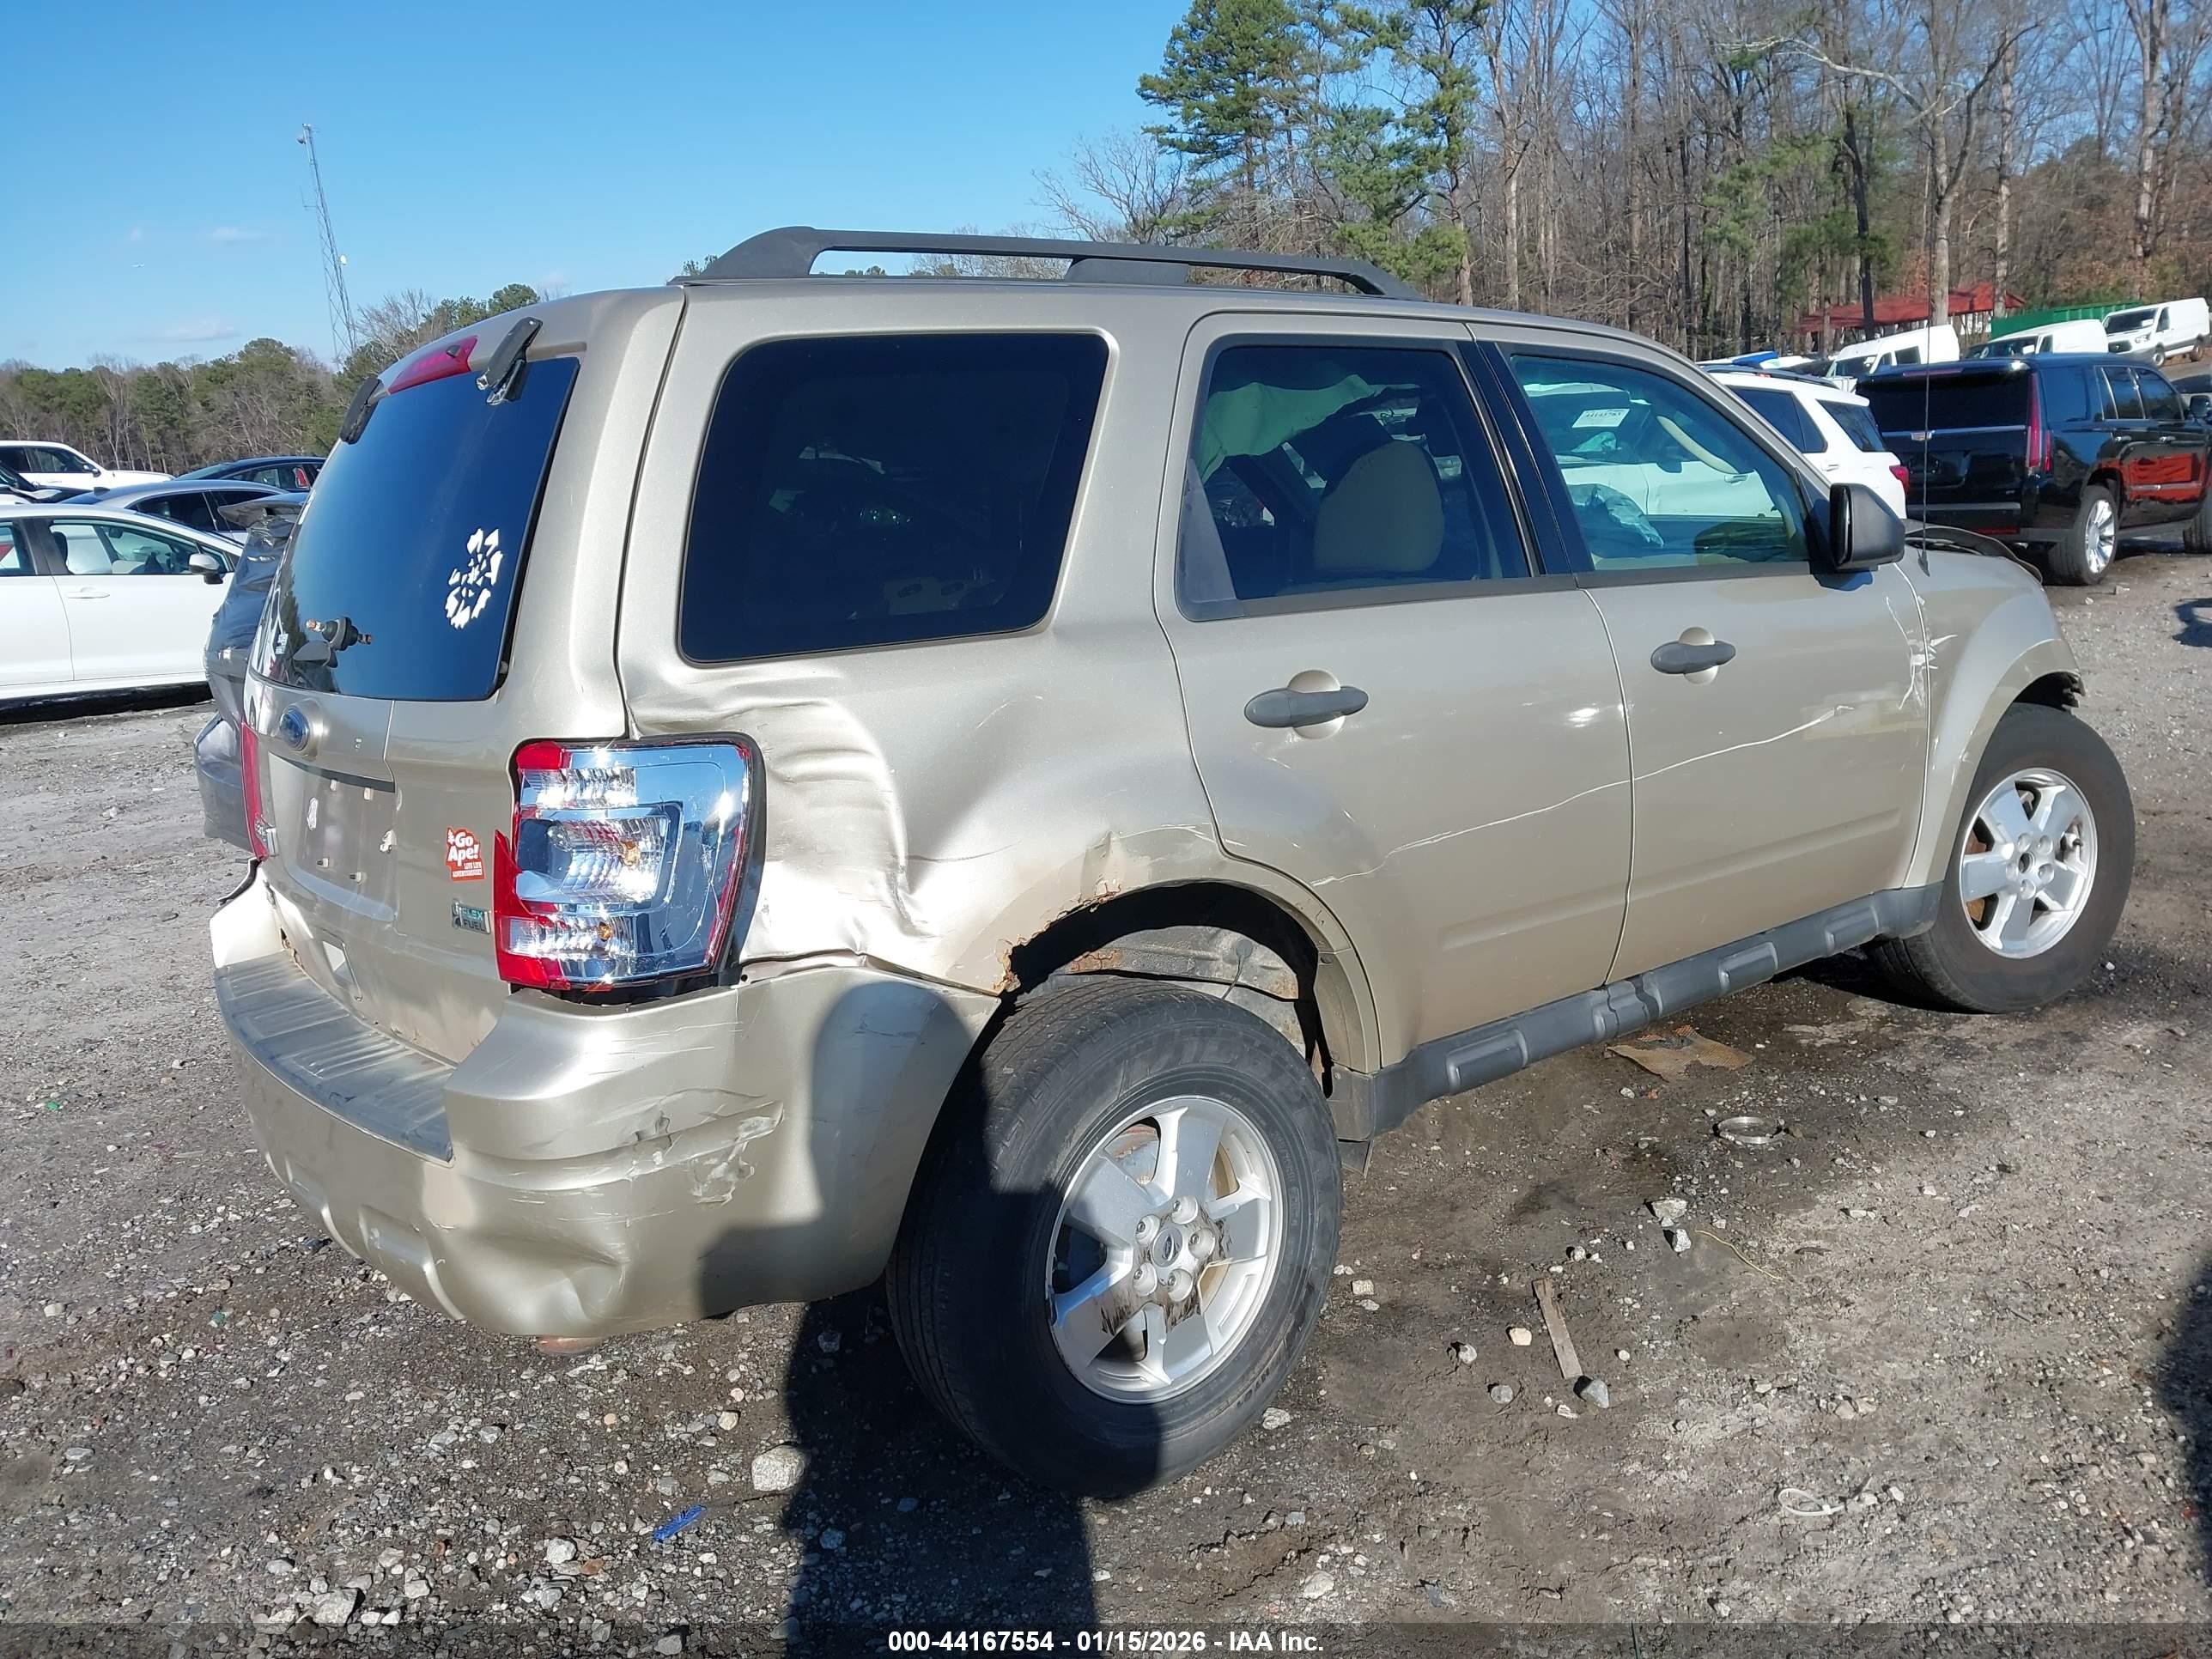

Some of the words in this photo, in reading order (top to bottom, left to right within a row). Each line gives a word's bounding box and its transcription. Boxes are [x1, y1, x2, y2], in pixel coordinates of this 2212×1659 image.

[455, 831, 474, 848] Go
[447, 844, 480, 866] Ape!
[462, 907, 483, 921] FLEX
[464, 919, 485, 932] FUEL
